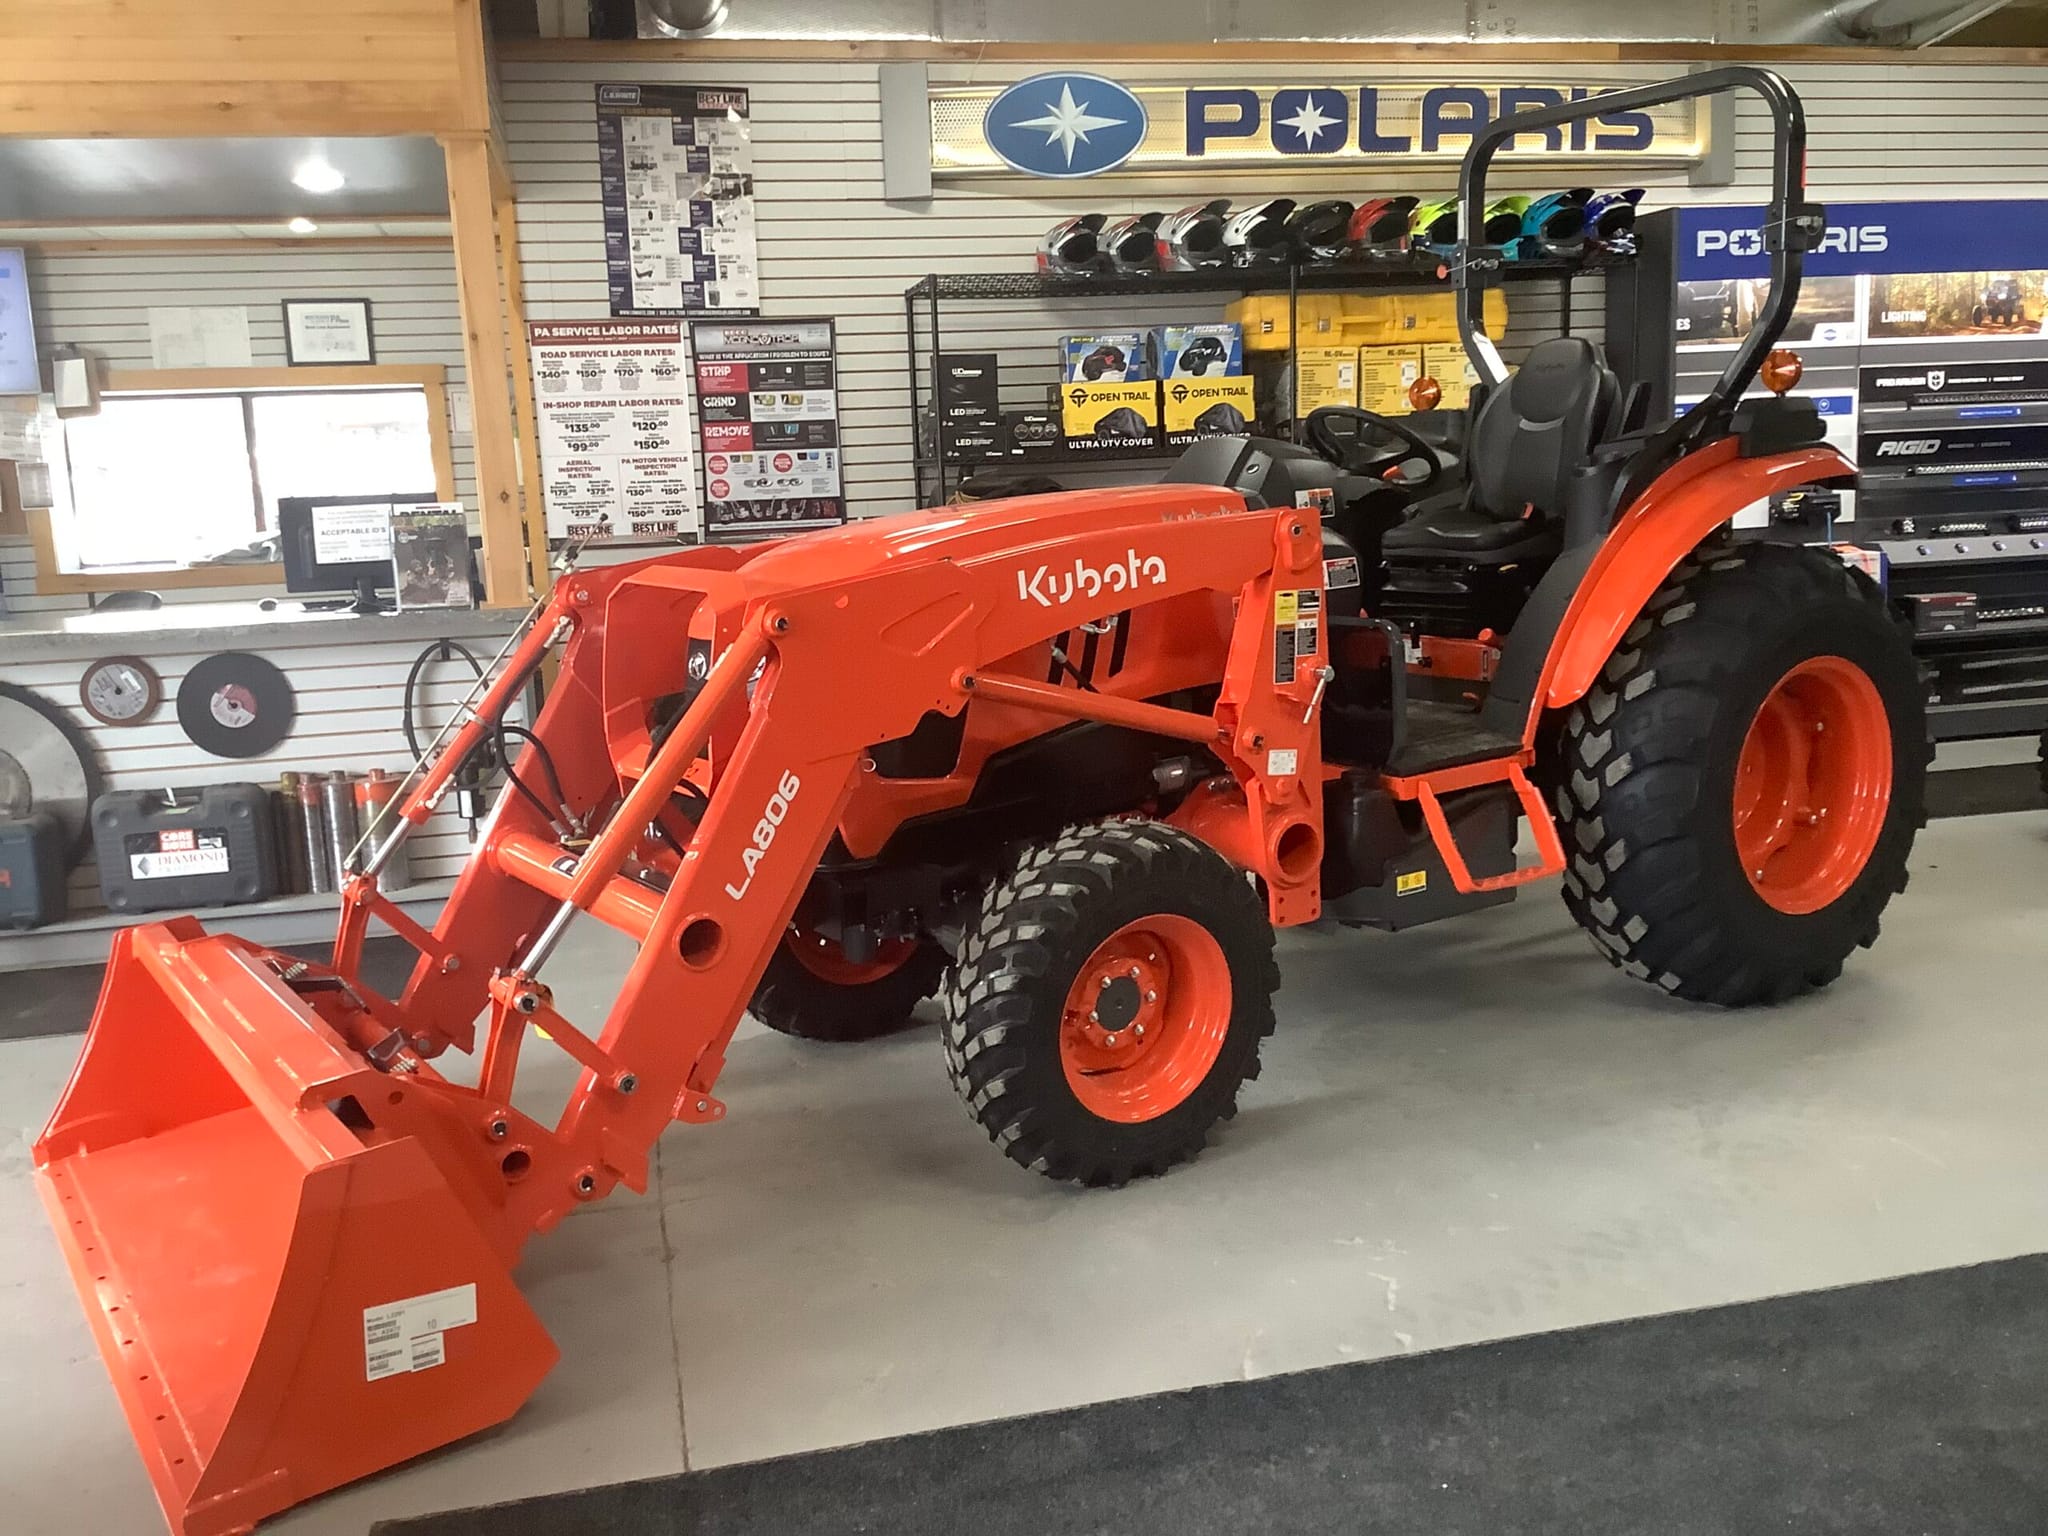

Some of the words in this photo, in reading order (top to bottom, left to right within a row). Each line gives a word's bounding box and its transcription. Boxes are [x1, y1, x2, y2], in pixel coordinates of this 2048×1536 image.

[699, 92, 720, 104] BEST
[1185, 86, 1655, 154] POLARIS
[1696, 225, 1889, 258] PORIS
[1880, 310, 1928, 324] LIGHTING
[534, 326, 551, 338] PA
[552, 325, 601, 337] SERVICE
[601, 324, 642, 336] LABOR
[642, 322, 679, 335] RATES
[540, 351, 568, 359] ROAD
[569, 350, 609, 358] SERVICE
[610, 349, 642, 357] LABOR
[643, 348, 676, 357] RATES:
[1090, 392, 1121, 402] OPEN
[1122, 391, 1151, 401] TRAIL
[1191, 388, 1220, 398] OPEN
[1220, 387, 1249, 397] TRAIL
[542, 400, 583, 410] IN-SHOP
[583, 400, 618, 409] REPAIR
[618, 399, 651, 408] LABOR
[651, 398, 684, 407] RATES:
[949, 407, 966, 416] LED
[564, 423, 601, 433] $135.00
[632, 420, 669, 431] $120.00
[704, 425, 751, 437] REMOVE
[633, 439, 670, 450] $150.00
[955, 438, 972, 447] LED
[1068, 440, 1100, 450] ULTRA
[1101, 439, 1121, 448] UTV
[1122, 437, 1154, 447] COVER
[1169, 435, 1200, 445] ULTRA
[567, 441, 600, 452] $99.00
[1876, 438, 1943, 457] RIGID
[558, 465, 602, 473] INSPECTION
[320, 528, 371, 536] ACCEPTABLE
[568, 525, 590, 536] BEST
[632, 523, 656, 534] BEST
[656, 521, 679, 532] LINE
[1016, 548, 1168, 608] Kubota
[724, 768, 801, 901] LA806
[157, 851, 225, 866] DIAMOND
